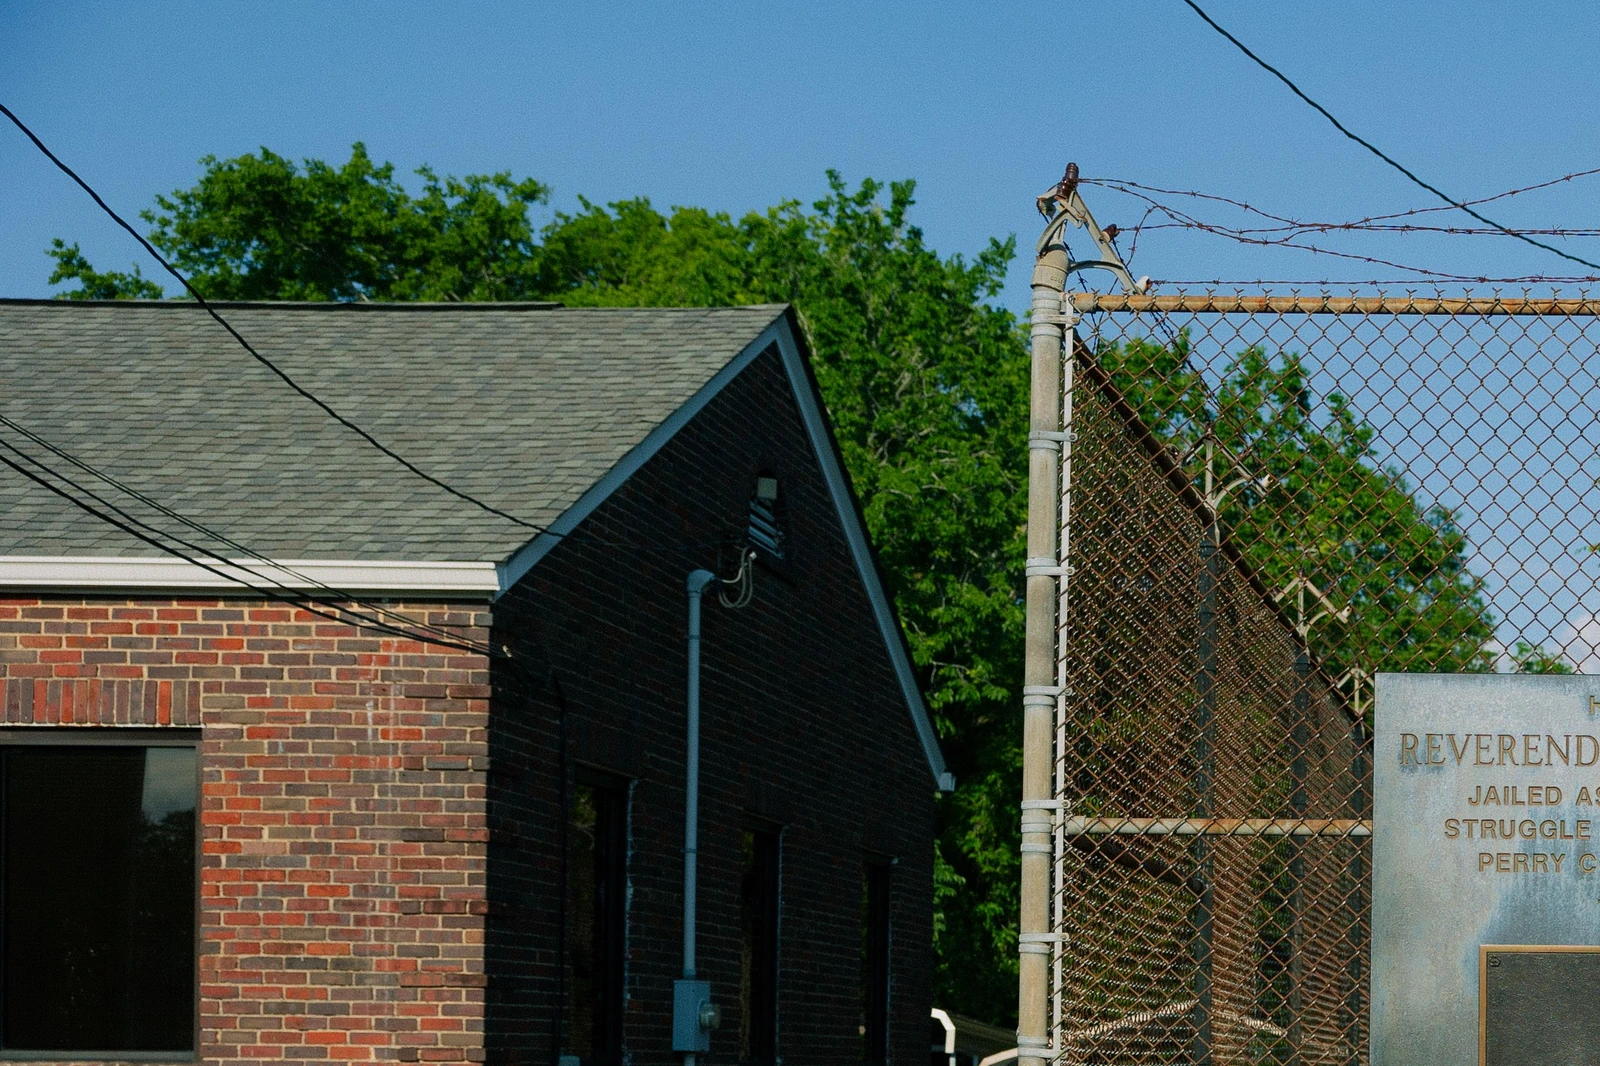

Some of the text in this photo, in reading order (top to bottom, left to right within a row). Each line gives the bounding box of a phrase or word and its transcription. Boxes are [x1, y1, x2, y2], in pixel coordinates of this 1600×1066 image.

[1400, 733, 1600, 767] REVEREND
[1468, 786, 1562, 806] JAILED
[1444, 819, 1590, 840] STRUGGLE
[1478, 853, 1565, 873] PERRY
